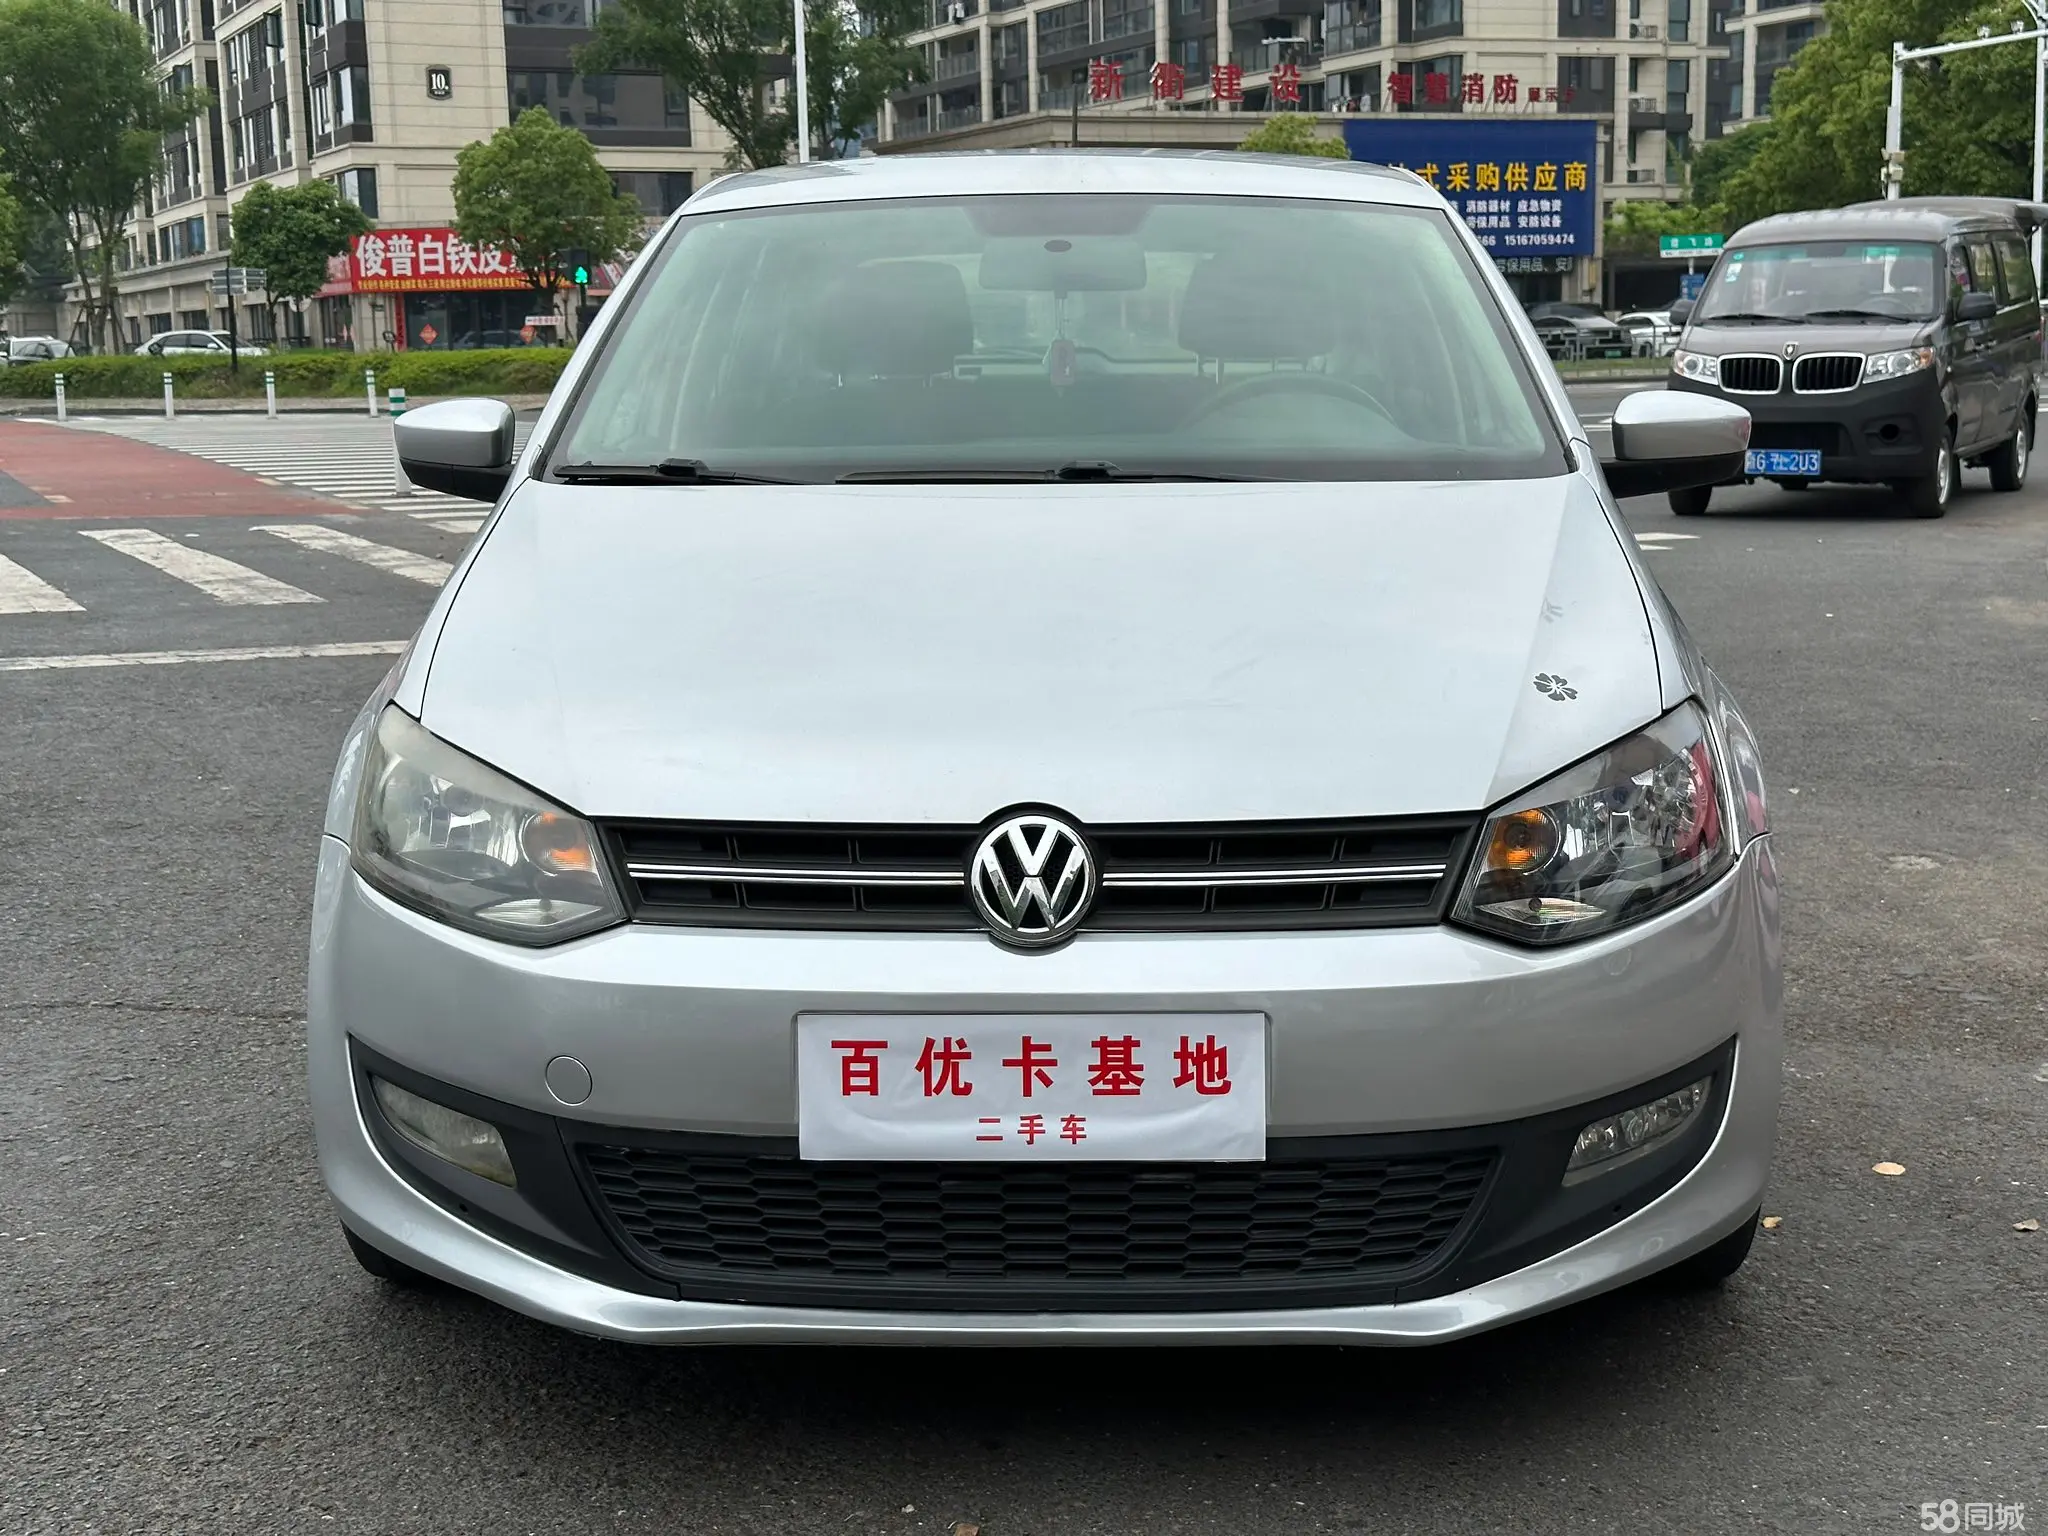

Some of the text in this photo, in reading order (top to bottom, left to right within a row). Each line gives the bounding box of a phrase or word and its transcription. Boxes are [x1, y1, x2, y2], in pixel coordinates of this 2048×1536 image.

[1388, 72, 1519, 104] 智慧消防
[1389, 161, 1588, 192] 式采购供应商
[1517, 214, 1562, 228] 安防设备
[355, 234, 522, 277] 俊普白铁皮
[1504, 234, 1575, 246] 15167059474
[830, 1034, 1232, 1098] 百优卡基地
[976, 1113, 1088, 1146] 二手车
